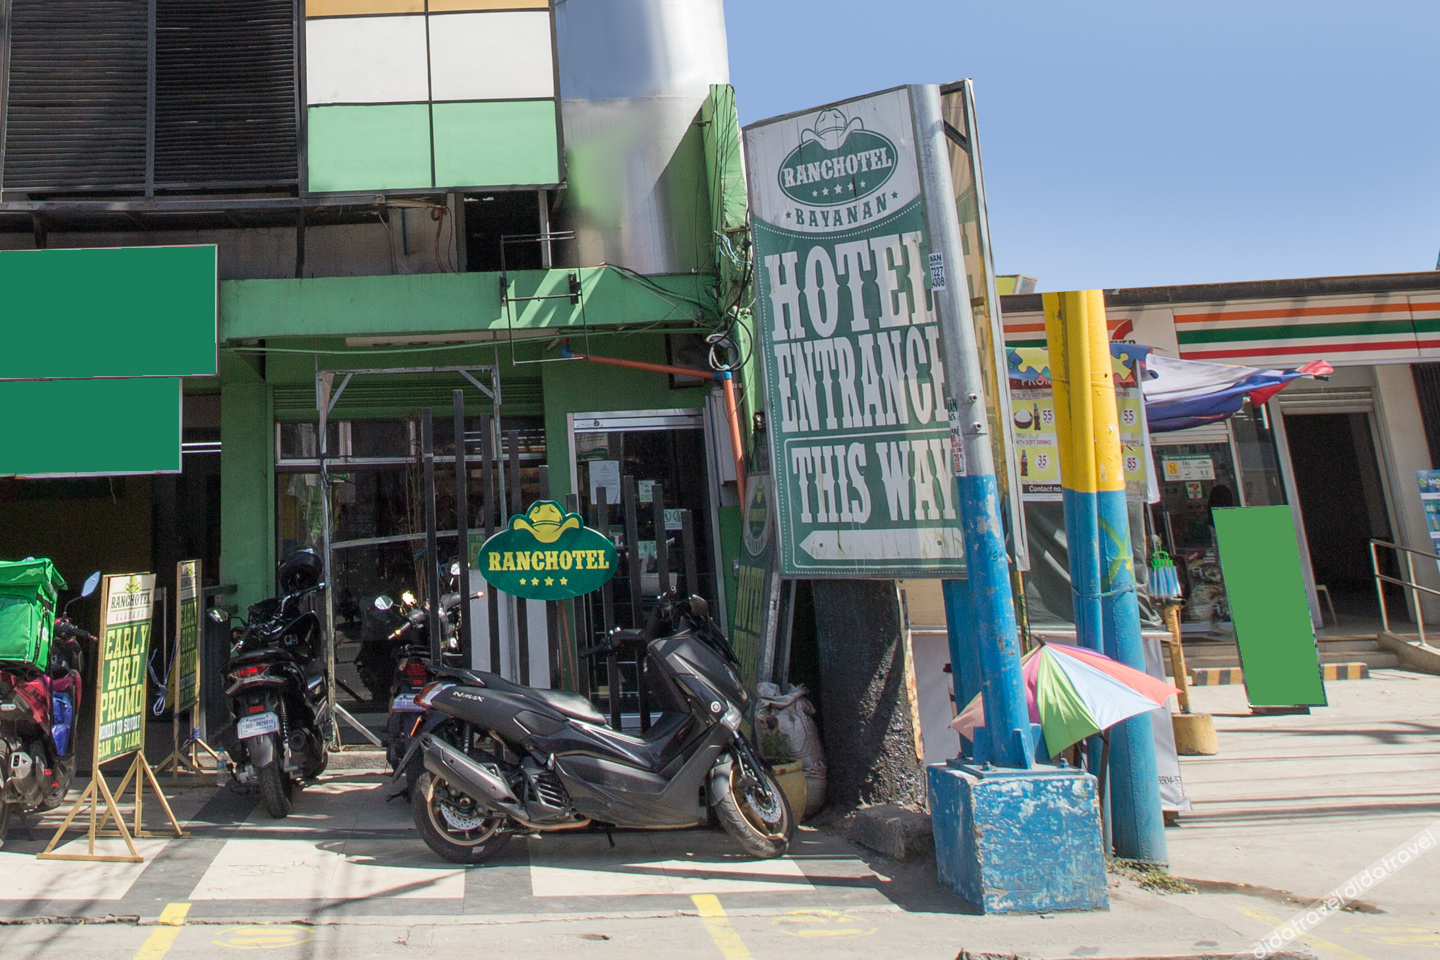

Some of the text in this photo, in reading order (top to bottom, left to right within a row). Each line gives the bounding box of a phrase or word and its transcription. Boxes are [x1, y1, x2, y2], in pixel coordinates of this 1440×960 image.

[783, 147, 893, 188] RANCHOTEL
[794, 193, 888, 228] BAYANAN
[764, 230, 938, 341] HOTEL
[773, 325, 951, 433] ENTRANCE
[1042, 409, 1053, 421] 55
[1123, 409, 1134, 421] 55
[1038, 454, 1047, 466] 35
[1127, 457, 1137, 469] 85
[791, 438, 956, 524] THIS WAY
[488, 550, 610, 571] RANCHOTEL
[111, 592, 151, 609] RANCHOTEL
[105, 625, 149, 661] EARLY
[108, 655, 141, 691] BIRD
[100, 684, 143, 724] PROMO
[114, 736, 123, 753] TO
